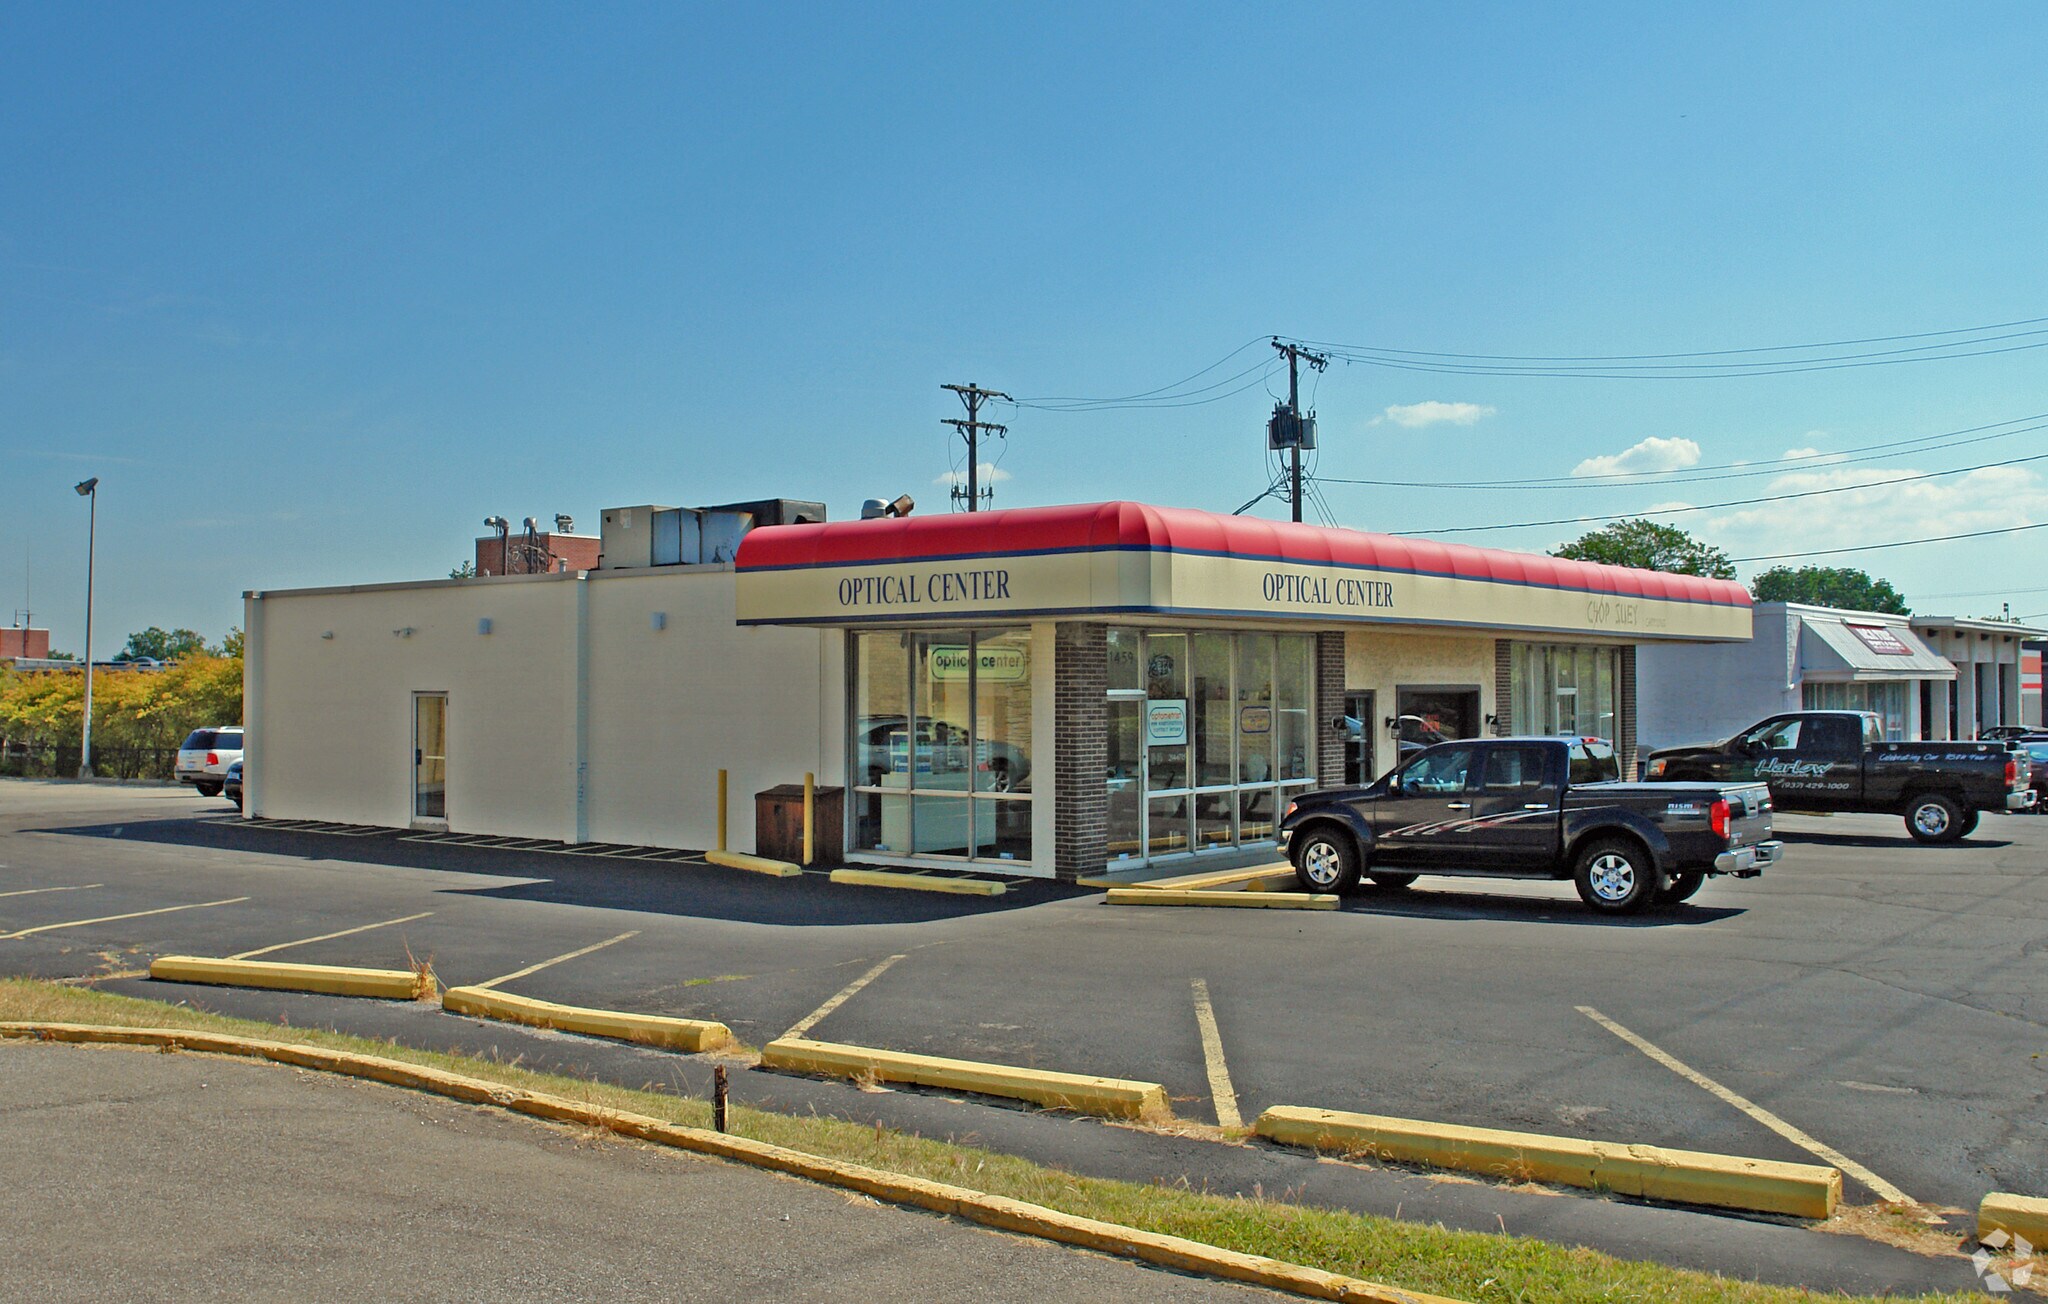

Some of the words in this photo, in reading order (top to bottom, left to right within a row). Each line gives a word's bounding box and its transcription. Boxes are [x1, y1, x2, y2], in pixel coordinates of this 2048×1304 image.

[838, 574, 921, 606] OPTICAL
[927, 570, 1011, 603] CENTER
[1262, 572, 1332, 605] OPTICAL
[1336, 578, 1394, 608] CENTER
[935, 654, 978, 672] optic
[981, 653, 1021, 668] center
[1805, 782, 1850, 790] 429-1000
